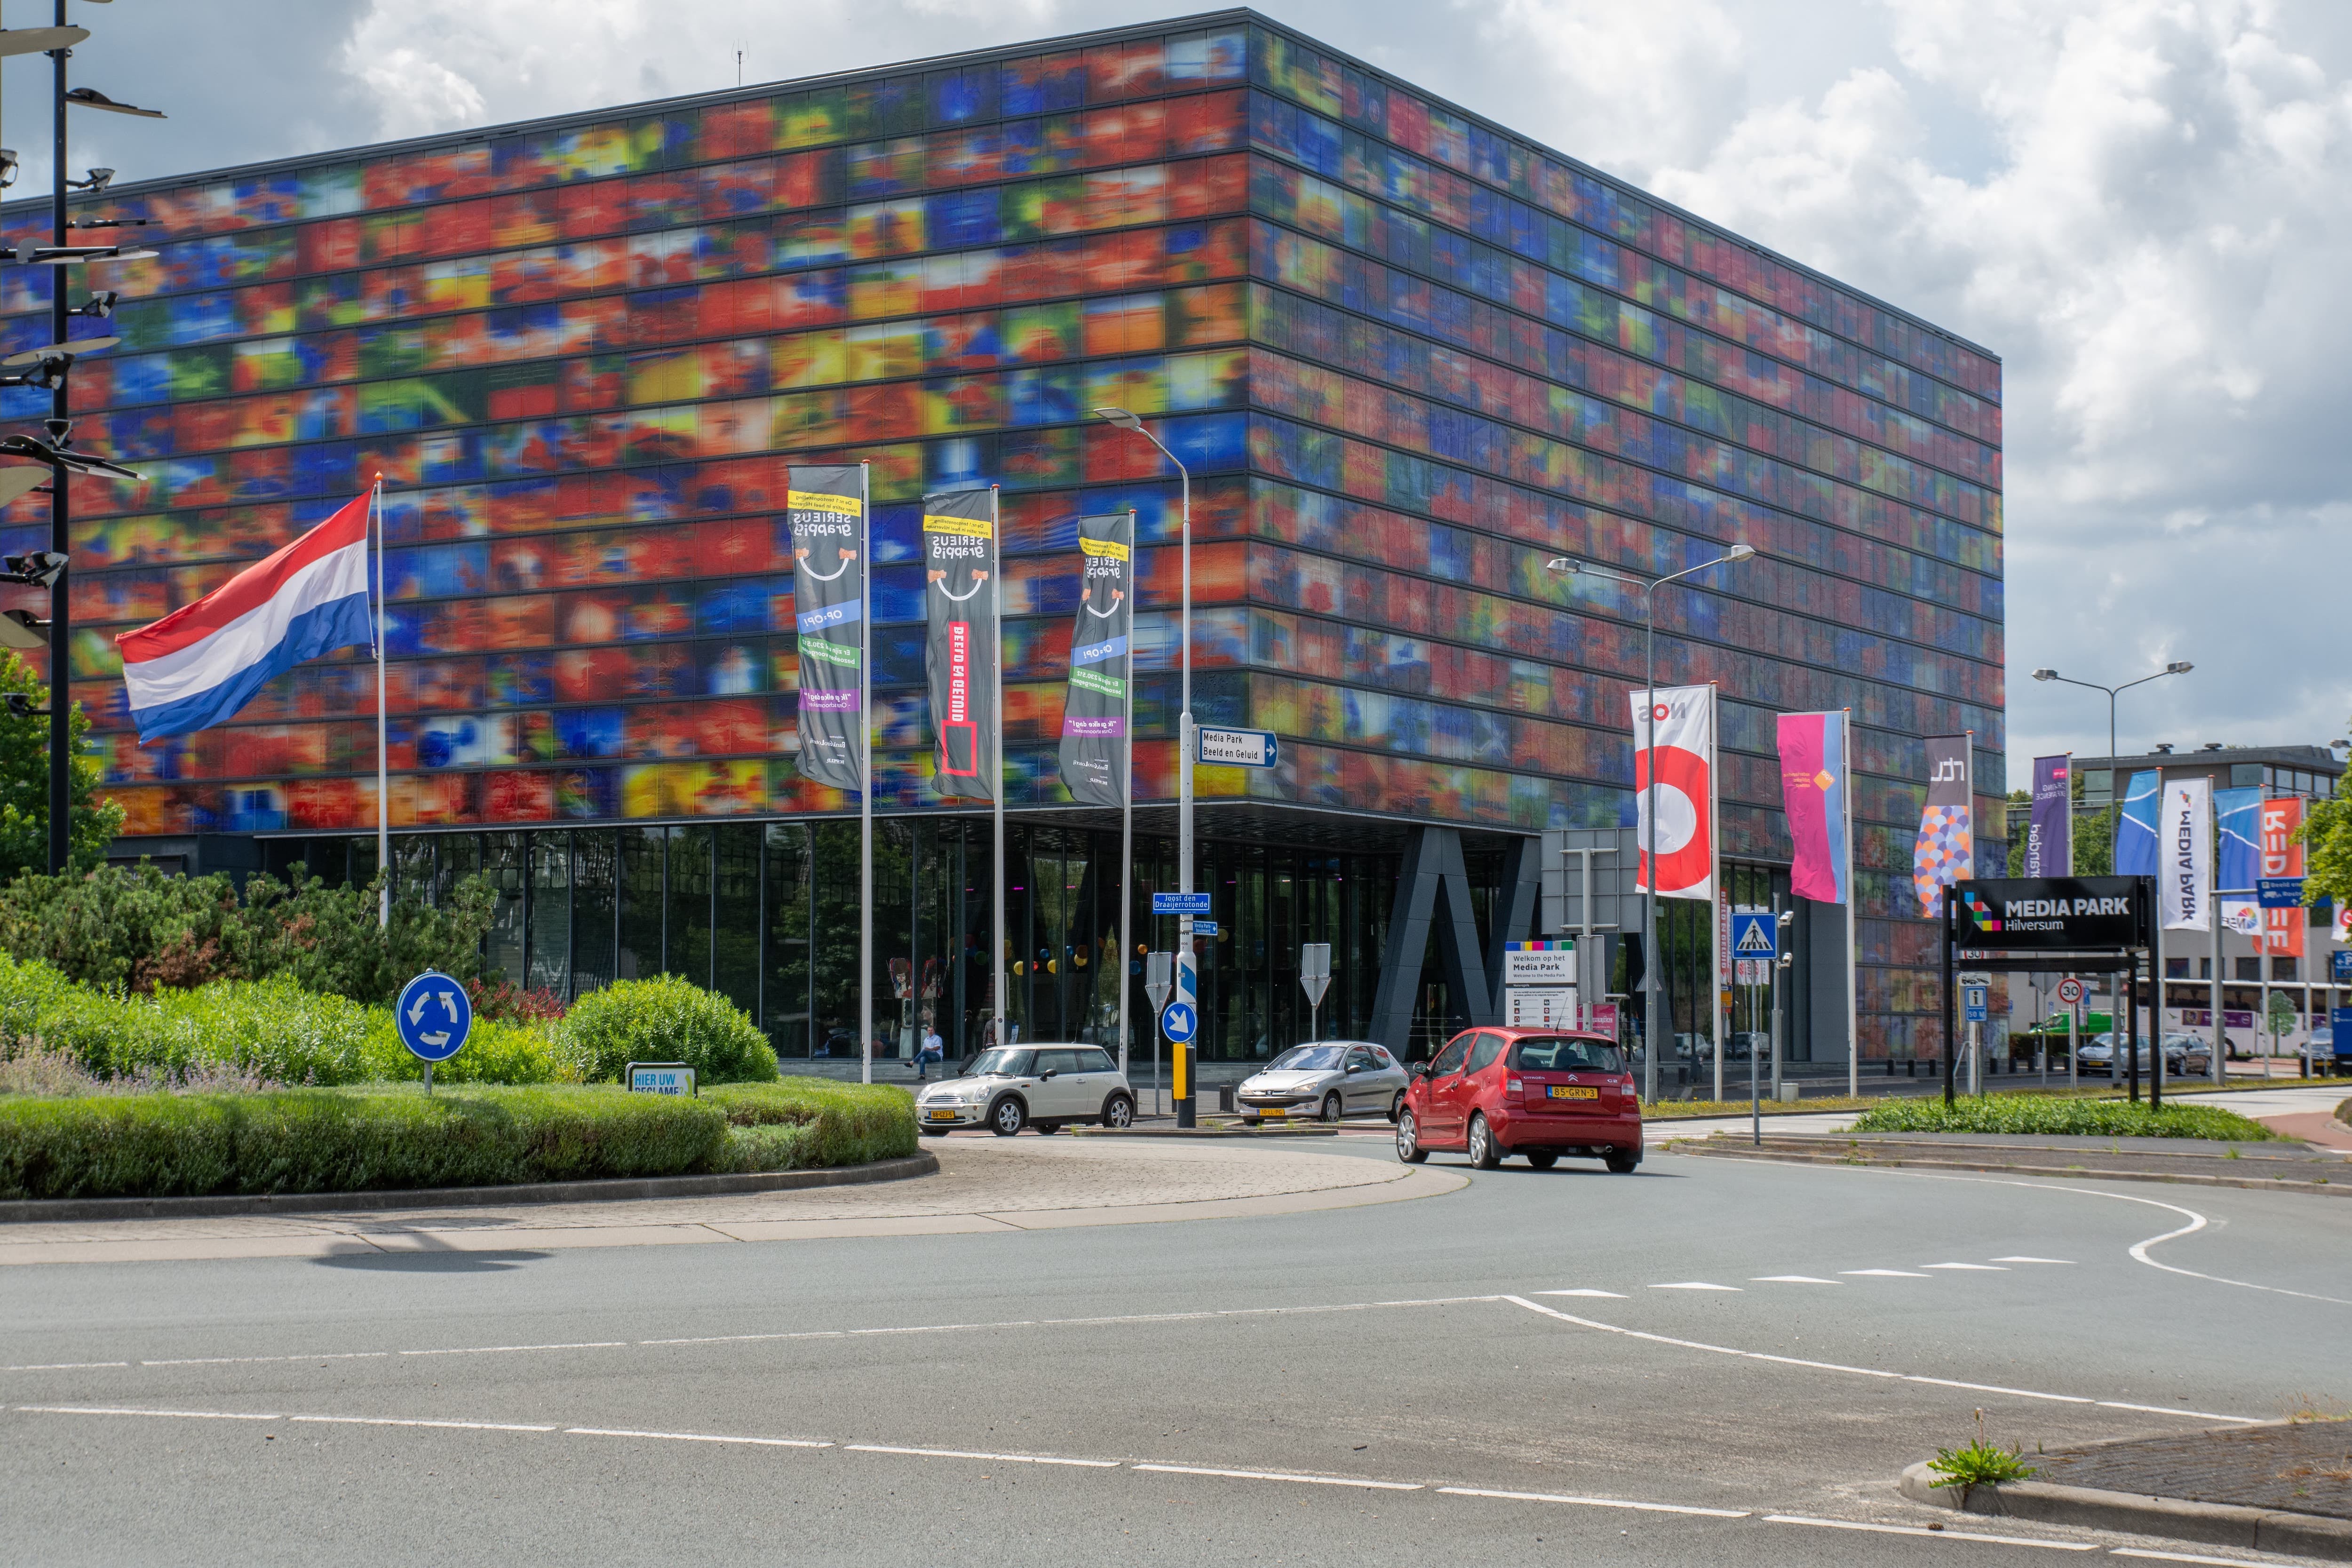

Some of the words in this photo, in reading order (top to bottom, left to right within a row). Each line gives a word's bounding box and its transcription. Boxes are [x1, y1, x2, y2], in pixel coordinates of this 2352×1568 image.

[1204, 732, 1224, 742] Media
[1227, 734, 1242, 744] Park
[1204, 747, 1223, 756] Beeld
[1236, 749, 1257, 759] Geluid
[2006, 899, 2072, 917] MEDIA
[2074, 897, 2130, 915] PARK
[2005, 919, 2064, 931] Hilversum
[2063, 987, 2078, 996] 30
[635, 1074, 656, 1085] HIER
[659, 1074, 675, 1085] UW
[1554, 1088, 1595, 1097] 85-GRN-3
